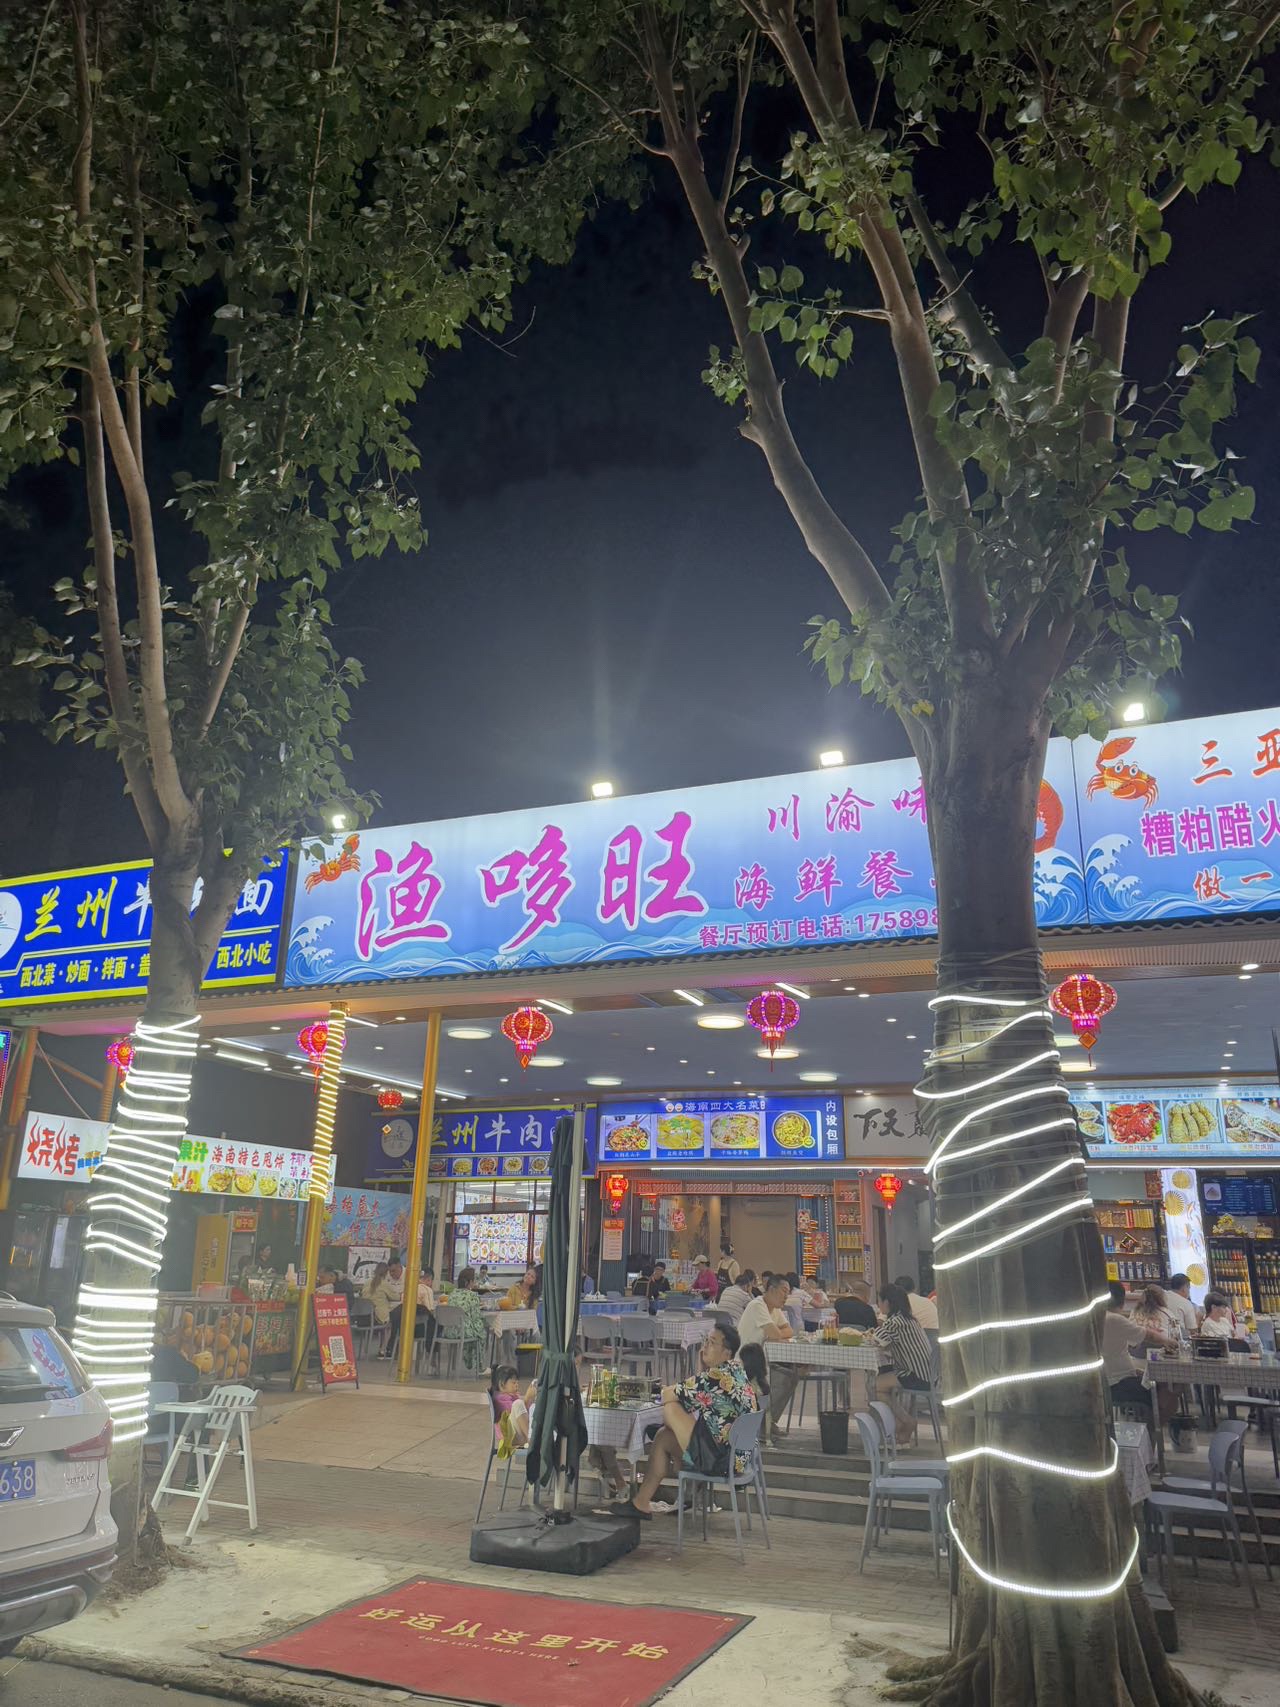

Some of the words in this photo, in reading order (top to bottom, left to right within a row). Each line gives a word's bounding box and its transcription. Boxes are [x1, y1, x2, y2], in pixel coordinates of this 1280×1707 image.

[1192, 728, 1280, 785] 三亚
[766, 776, 928, 841] 川渝味
[1140, 799, 1280, 858] 糟粕醋火
[356, 810, 707, 960] 渔哆旺
[734, 850, 938, 911] 海鲜餐
[1194, 867, 1273, 902] 做一
[217, 940, 272, 970] 西北小吃
[25, 1115, 81, 1177] 烧烤
[429, 1113, 588, 1152] 兰州牛肉
[826, 1100, 838, 1155] 内设包厢
[358, 1607, 669, 1660] 好运从这里开始
